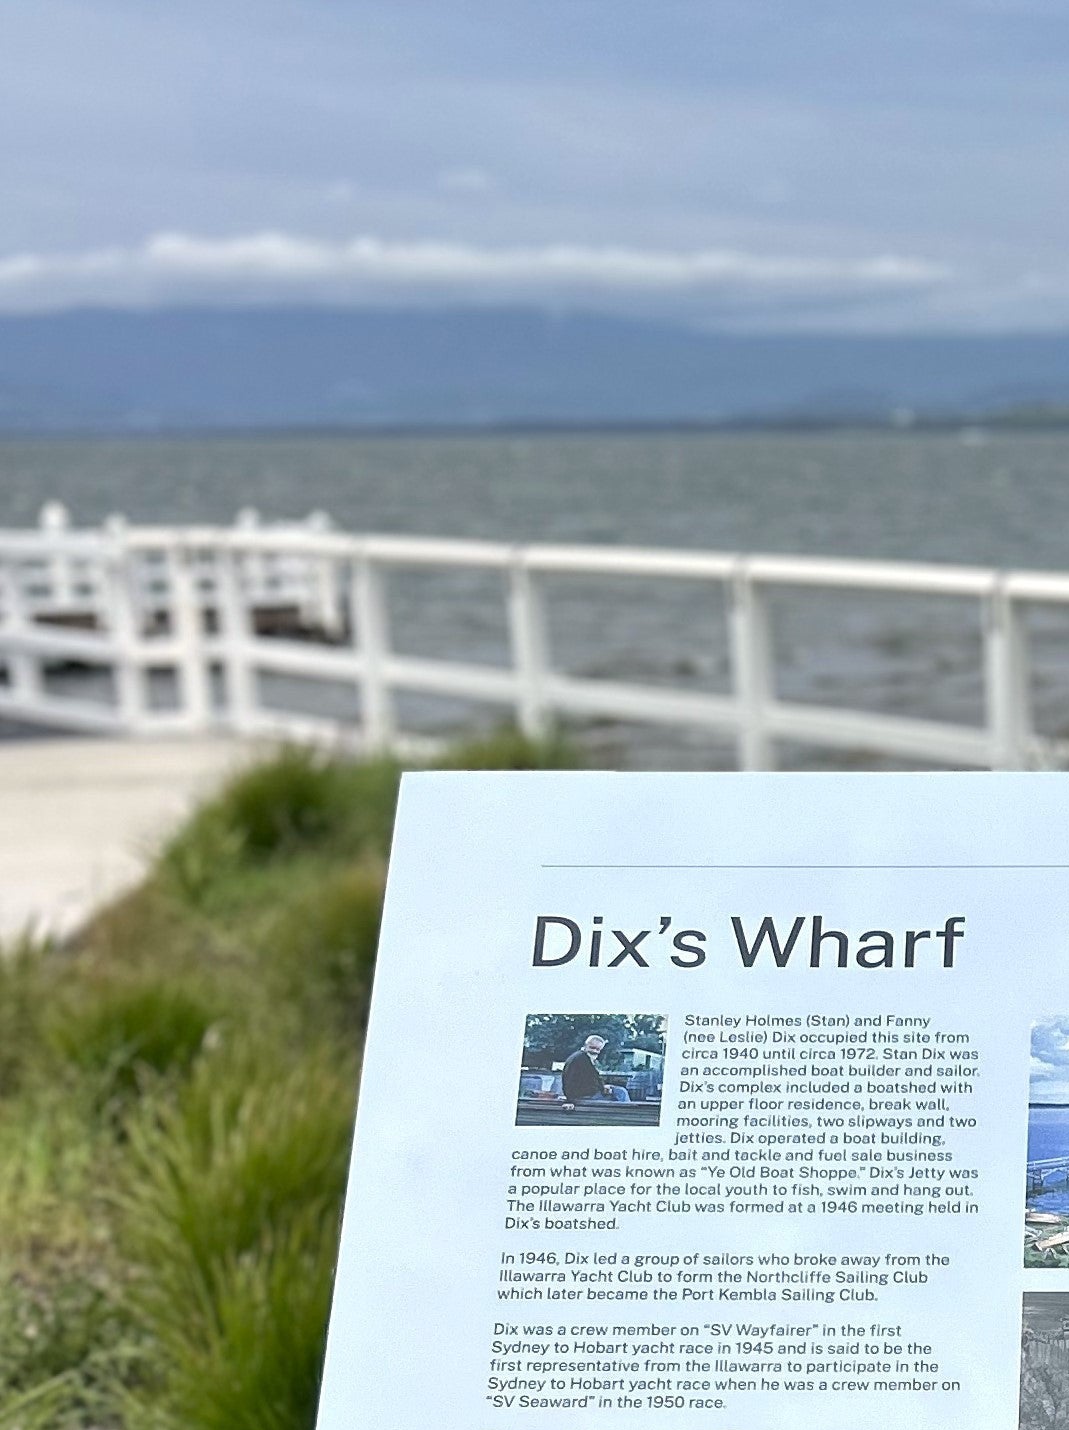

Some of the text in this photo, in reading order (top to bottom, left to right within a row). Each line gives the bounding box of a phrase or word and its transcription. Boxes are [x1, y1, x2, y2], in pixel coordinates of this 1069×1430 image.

[532, 915, 965, 968] Dix’s Wharf
[684, 1014, 931, 1030] Stanley Holmes (Stan) and Fanny
[683, 1031, 970, 1047] (nee Leslie) Dix occupied this site from
[681, 1047, 979, 1060] circa 1940 until circa 1972. Stan Dix was
[680, 1064, 980, 1079] an accomplished boat builder and sailor.
[677, 1098, 951, 1113] an upper floor residence, break wall,
[676, 1114, 977, 1130] mooring facilities, two slipways and two
[511, 1148, 953, 1163] canoe and boat hire, bait and tackle and fuel sale business
[504, 1217, 620, 1229] Dix’s boatshed.
[500, 1252, 950, 1270] In 1946, Dix led a group of sailors who broke away from the
[499, 1270, 928, 1287] Illawarra Yacht Club to form the Northcliffe Sailing Club
[497, 1287, 879, 1304] which later became the Port Kembla Sailing Club.
[489, 1359, 939, 1376] first representative from the Illawarra to participate in the
